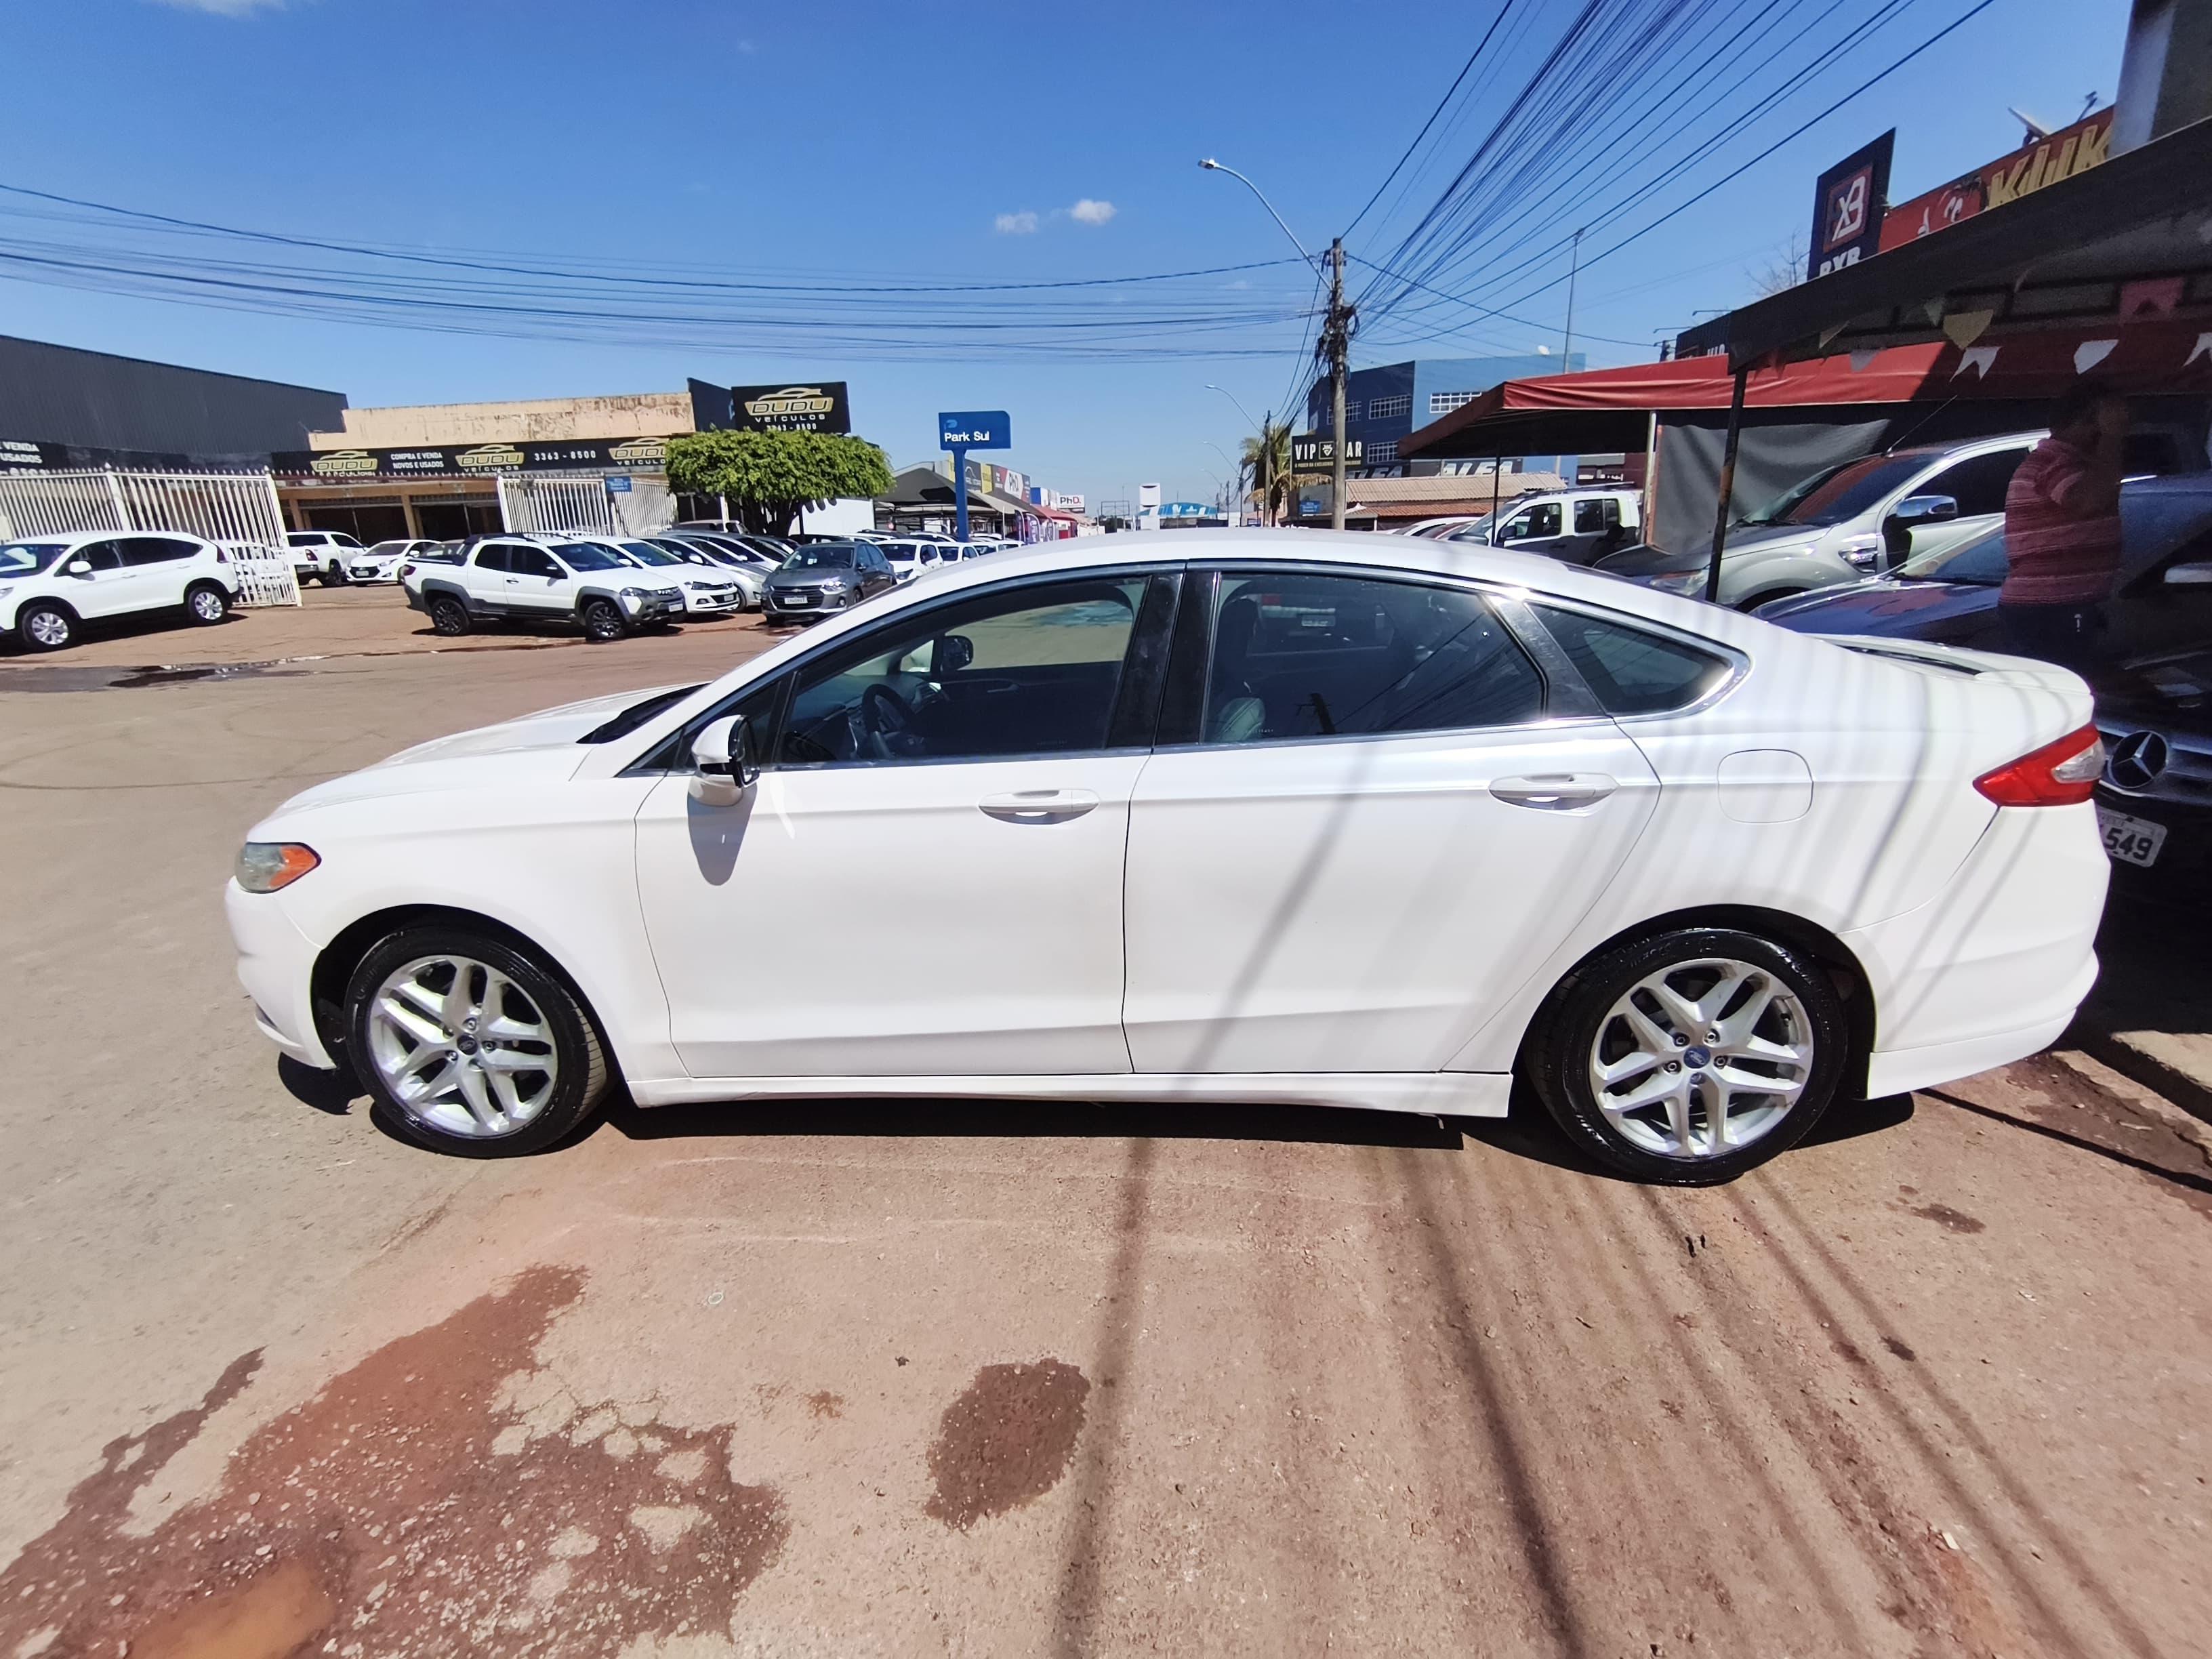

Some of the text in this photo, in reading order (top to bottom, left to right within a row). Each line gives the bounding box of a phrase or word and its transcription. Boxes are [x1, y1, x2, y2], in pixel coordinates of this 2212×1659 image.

[752, 401, 827, 413] DUDU
[944, 430, 989, 442] Park Sul
[2, 441, 39, 452] VENDA
[1295, 441, 1362, 460] VIP AR
[0, 453, 43, 464] USADOS
[462, 455, 520, 465] DUDU
[534, 452, 559, 461] 3363
[570, 450, 596, 459] 8500
[317, 461, 373, 470] DUDU
[1435, 461, 1513, 476] ALFA
[1060, 496, 1082, 504] PhD.
